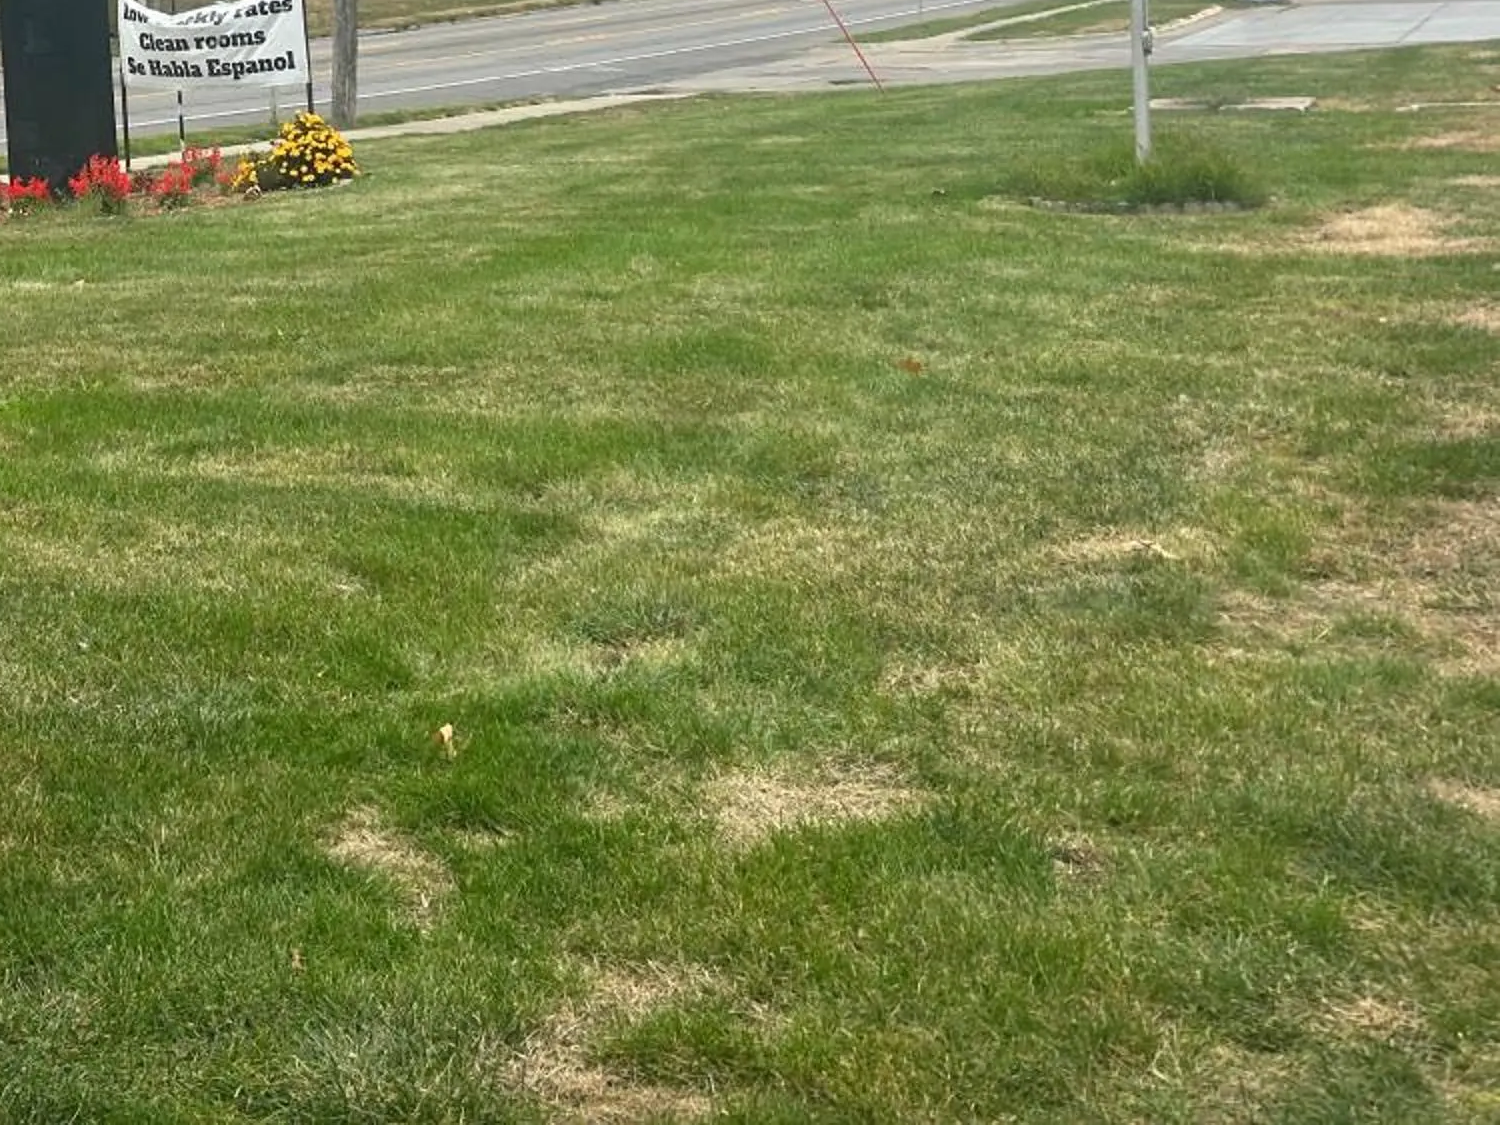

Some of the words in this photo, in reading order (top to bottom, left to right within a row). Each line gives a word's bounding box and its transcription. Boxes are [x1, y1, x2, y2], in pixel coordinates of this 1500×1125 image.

[139, 32, 190, 52] Clean
[193, 30, 266, 50] rooms
[127, 56, 146, 76] Se
[147, 59, 203, 78] Habla
[205, 50, 296, 80] Espanol
